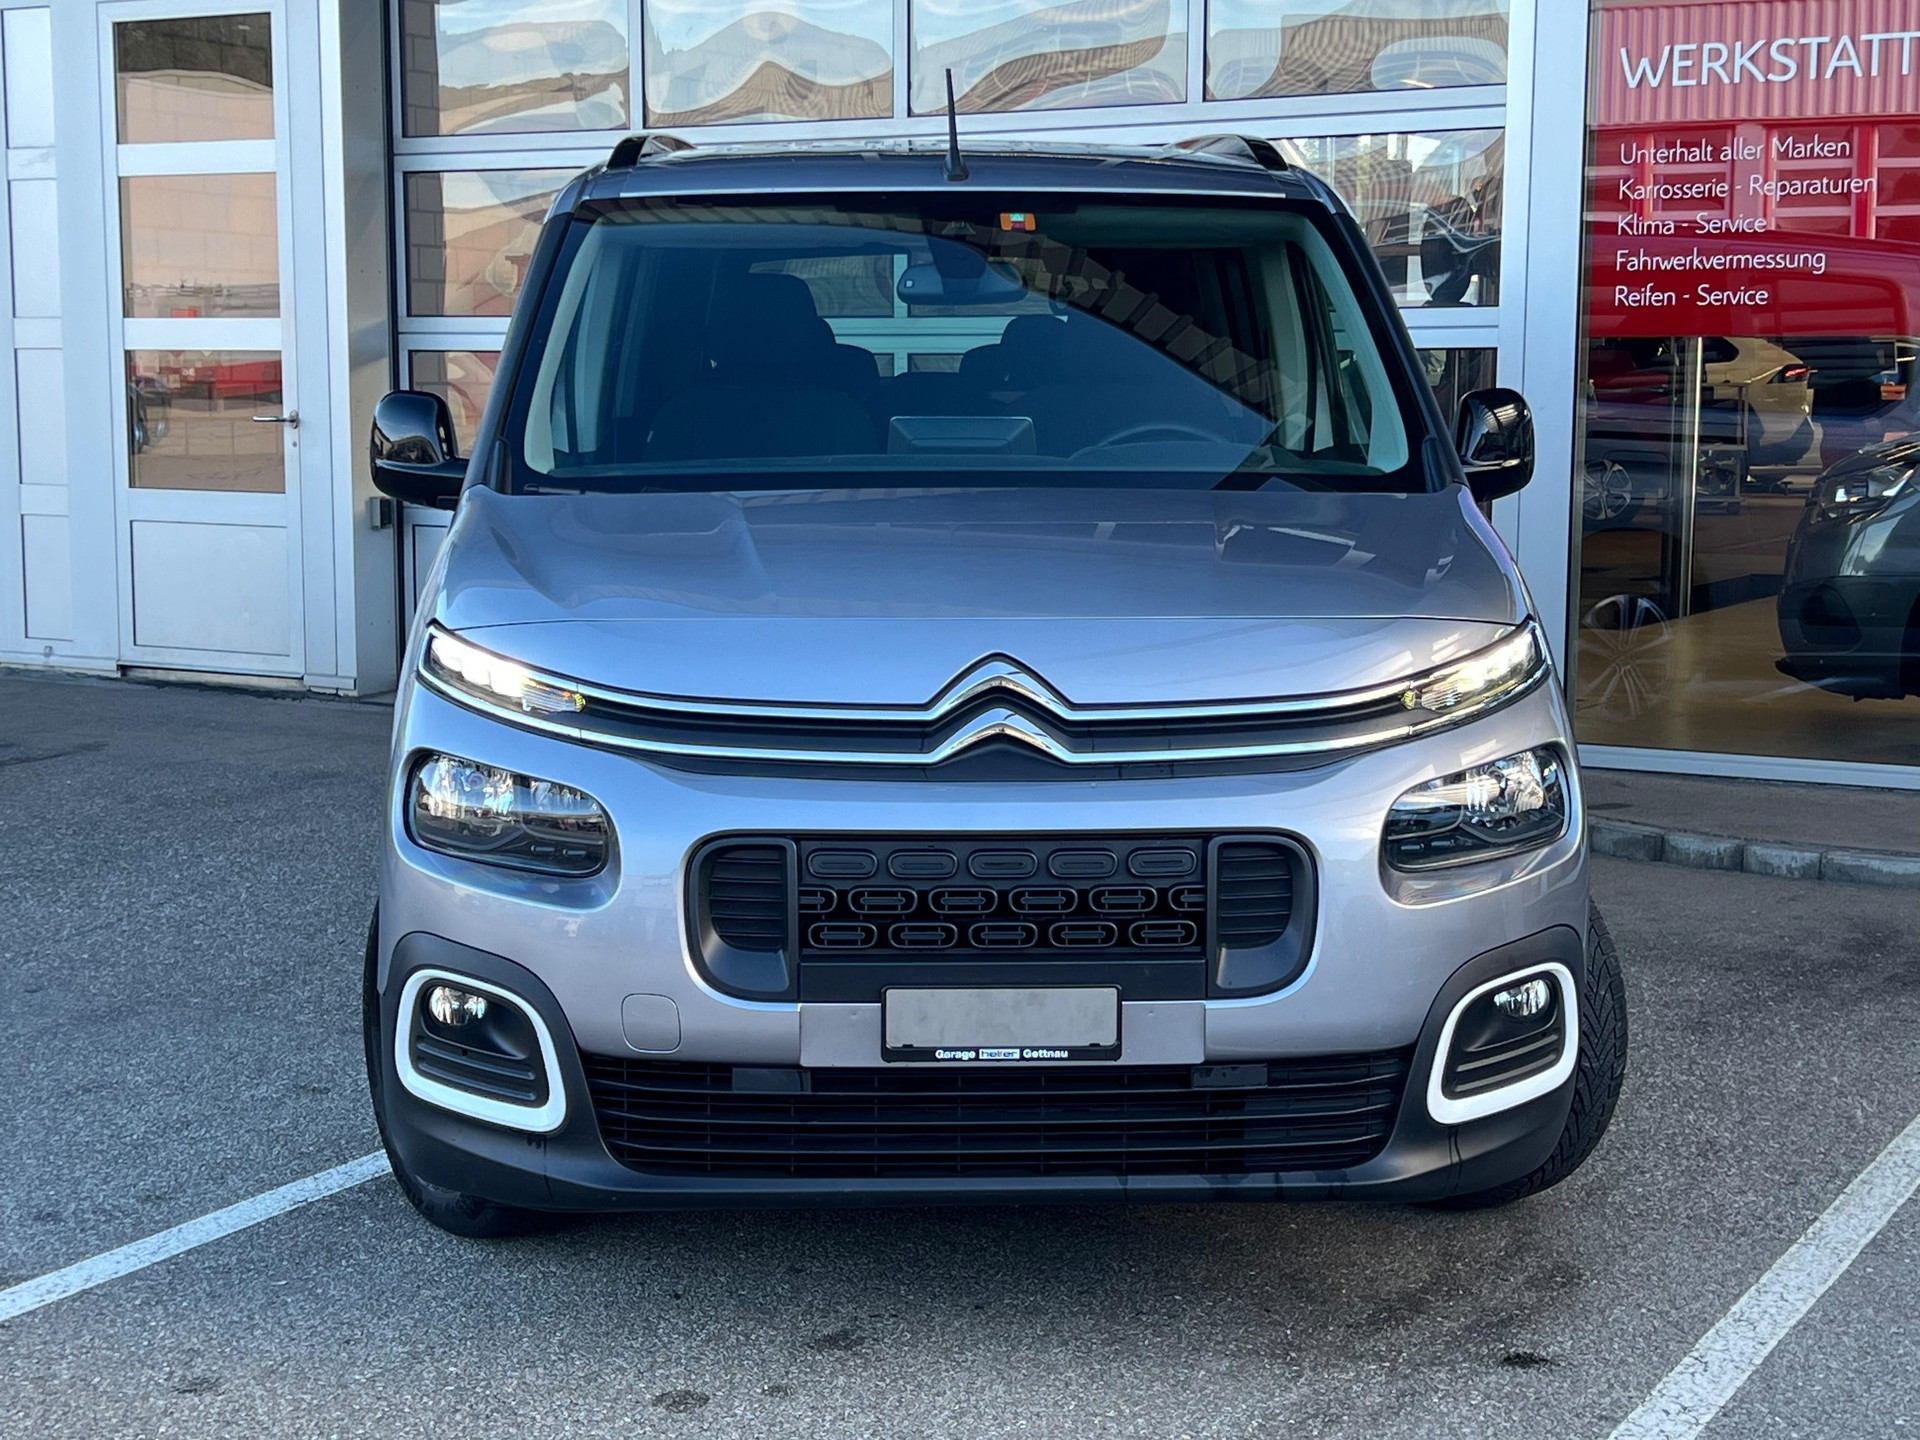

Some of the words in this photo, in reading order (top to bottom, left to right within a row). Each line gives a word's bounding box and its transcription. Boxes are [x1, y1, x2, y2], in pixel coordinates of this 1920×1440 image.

[1619, 31, 1920, 89] WERKSTATT
[1619, 142, 1713, 165] Unterhalt
[1720, 138, 1764, 162] aller
[1771, 133, 1850, 160] Marken
[1618, 178, 1729, 201] Karrosserie
[1749, 174, 1877, 202] Reparaturen
[1617, 214, 1675, 236] Klima
[1694, 212, 1768, 235] Service
[1615, 247, 1827, 274] Fahrwerkvermessung
[1614, 282, 1676, 307] Reifen
[1695, 283, 1769, 306] Service
[935, 1049, 976, 1060] Garage
